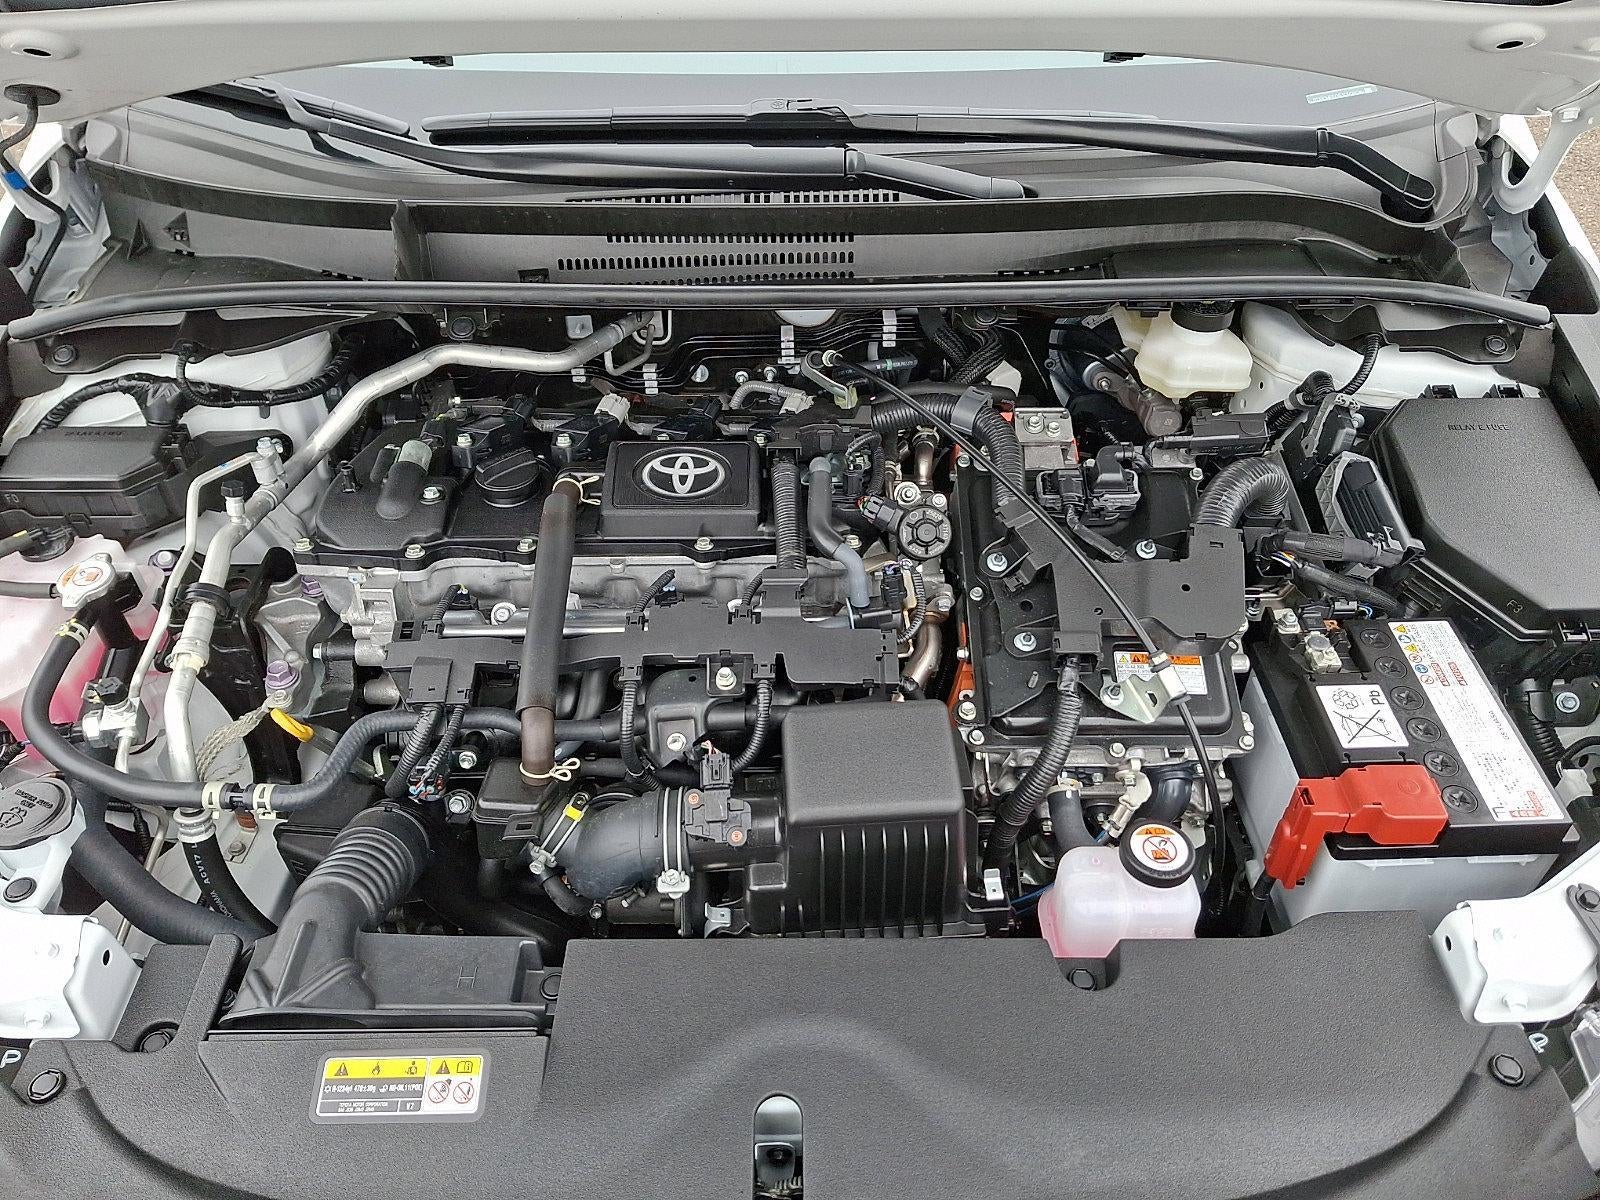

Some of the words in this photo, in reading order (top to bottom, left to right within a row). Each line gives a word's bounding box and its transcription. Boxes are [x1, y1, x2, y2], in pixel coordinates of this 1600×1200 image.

[456, 966, 478, 989] H
[1528, 1032, 1549, 1054] P
[0, 1049, 22, 1069] P
